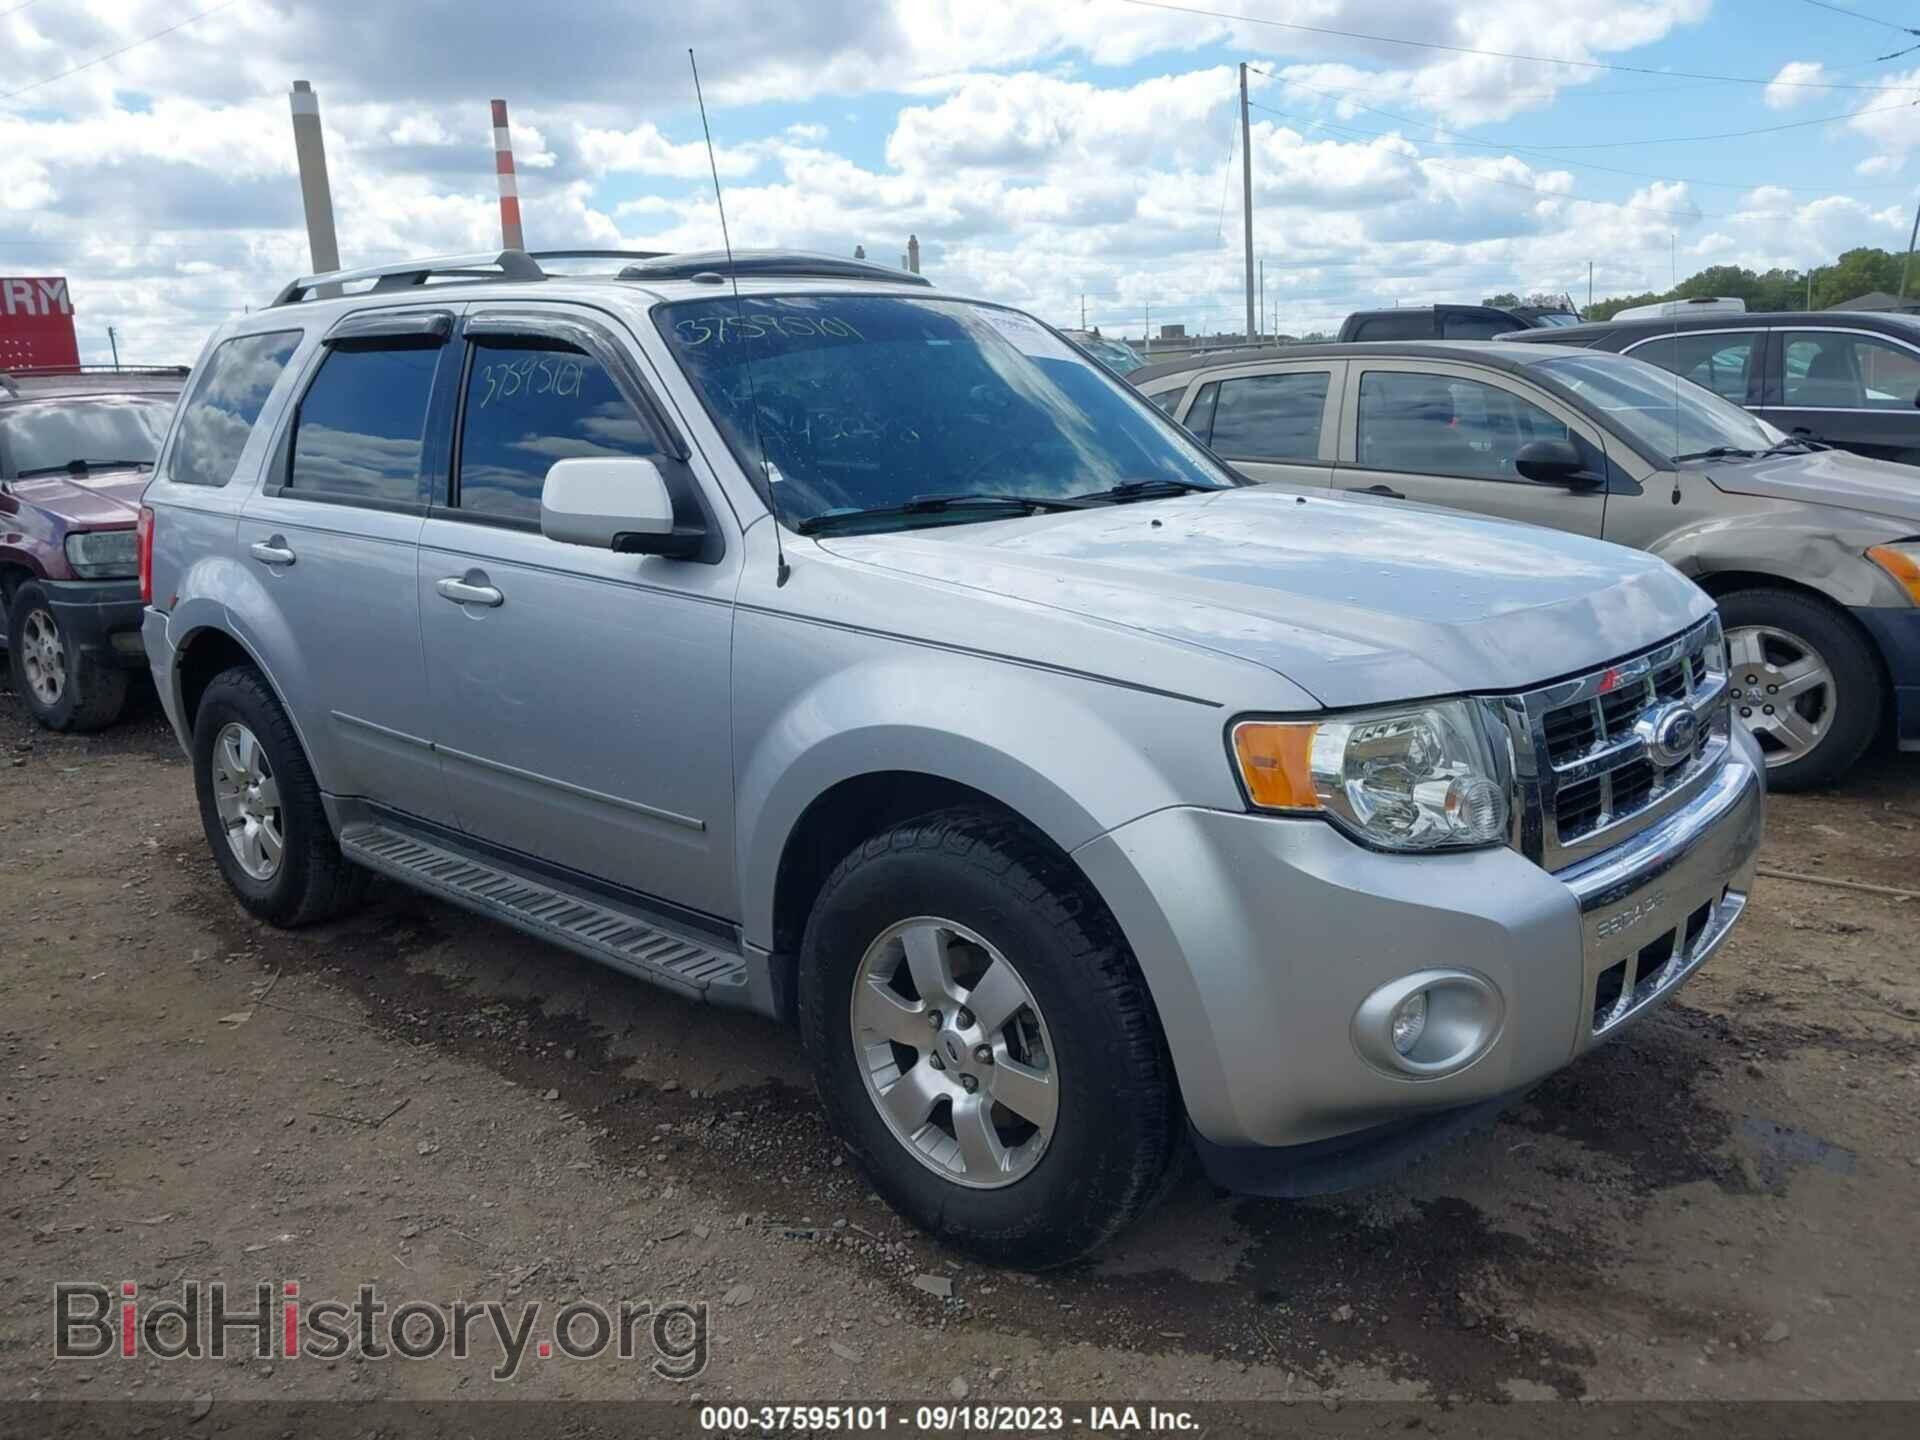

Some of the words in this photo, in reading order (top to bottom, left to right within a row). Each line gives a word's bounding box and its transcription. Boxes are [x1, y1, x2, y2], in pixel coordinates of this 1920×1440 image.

[0, 279, 69, 315] RM
[675, 314, 865, 345] 37595101
[479, 358, 583, 409] 37595101
